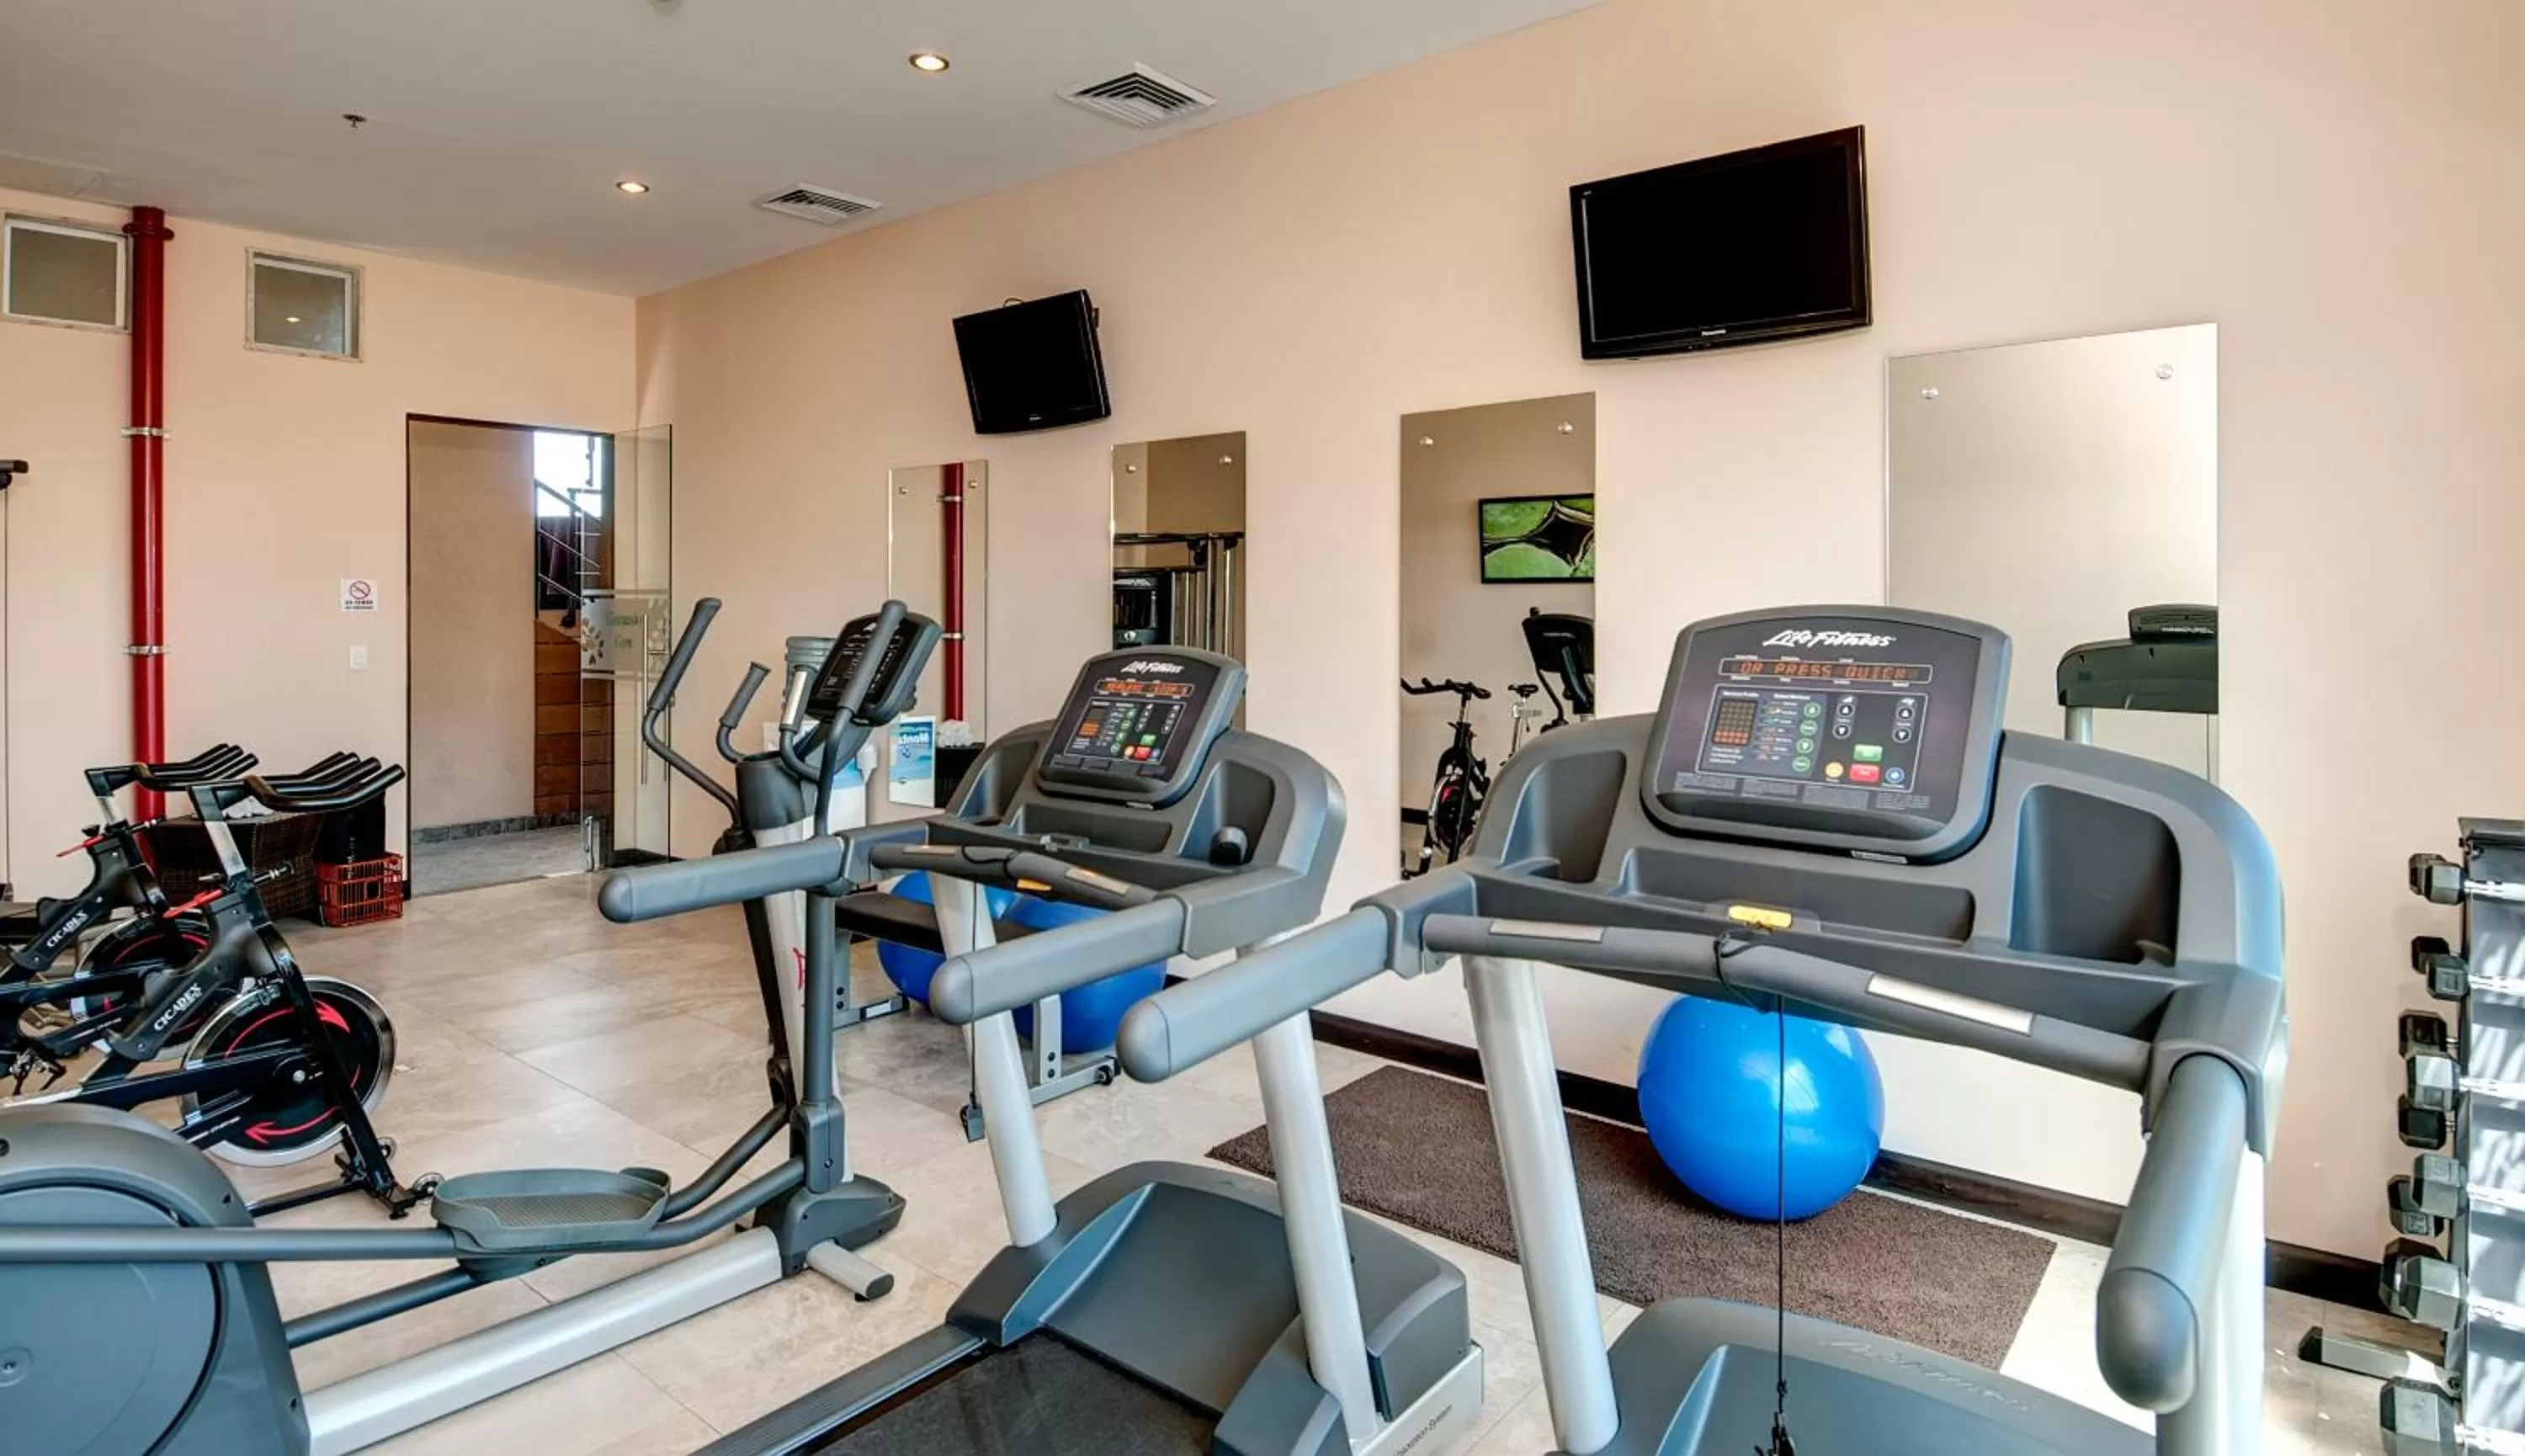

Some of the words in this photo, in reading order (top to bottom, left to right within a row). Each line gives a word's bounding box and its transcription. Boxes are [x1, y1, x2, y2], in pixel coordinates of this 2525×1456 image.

[1740, 661, 1764, 674] OR
[1773, 662, 1833, 678] PRESS
[1844, 666, 1907, 680] QUICK
[154, 982, 202, 1031] CICADEX
